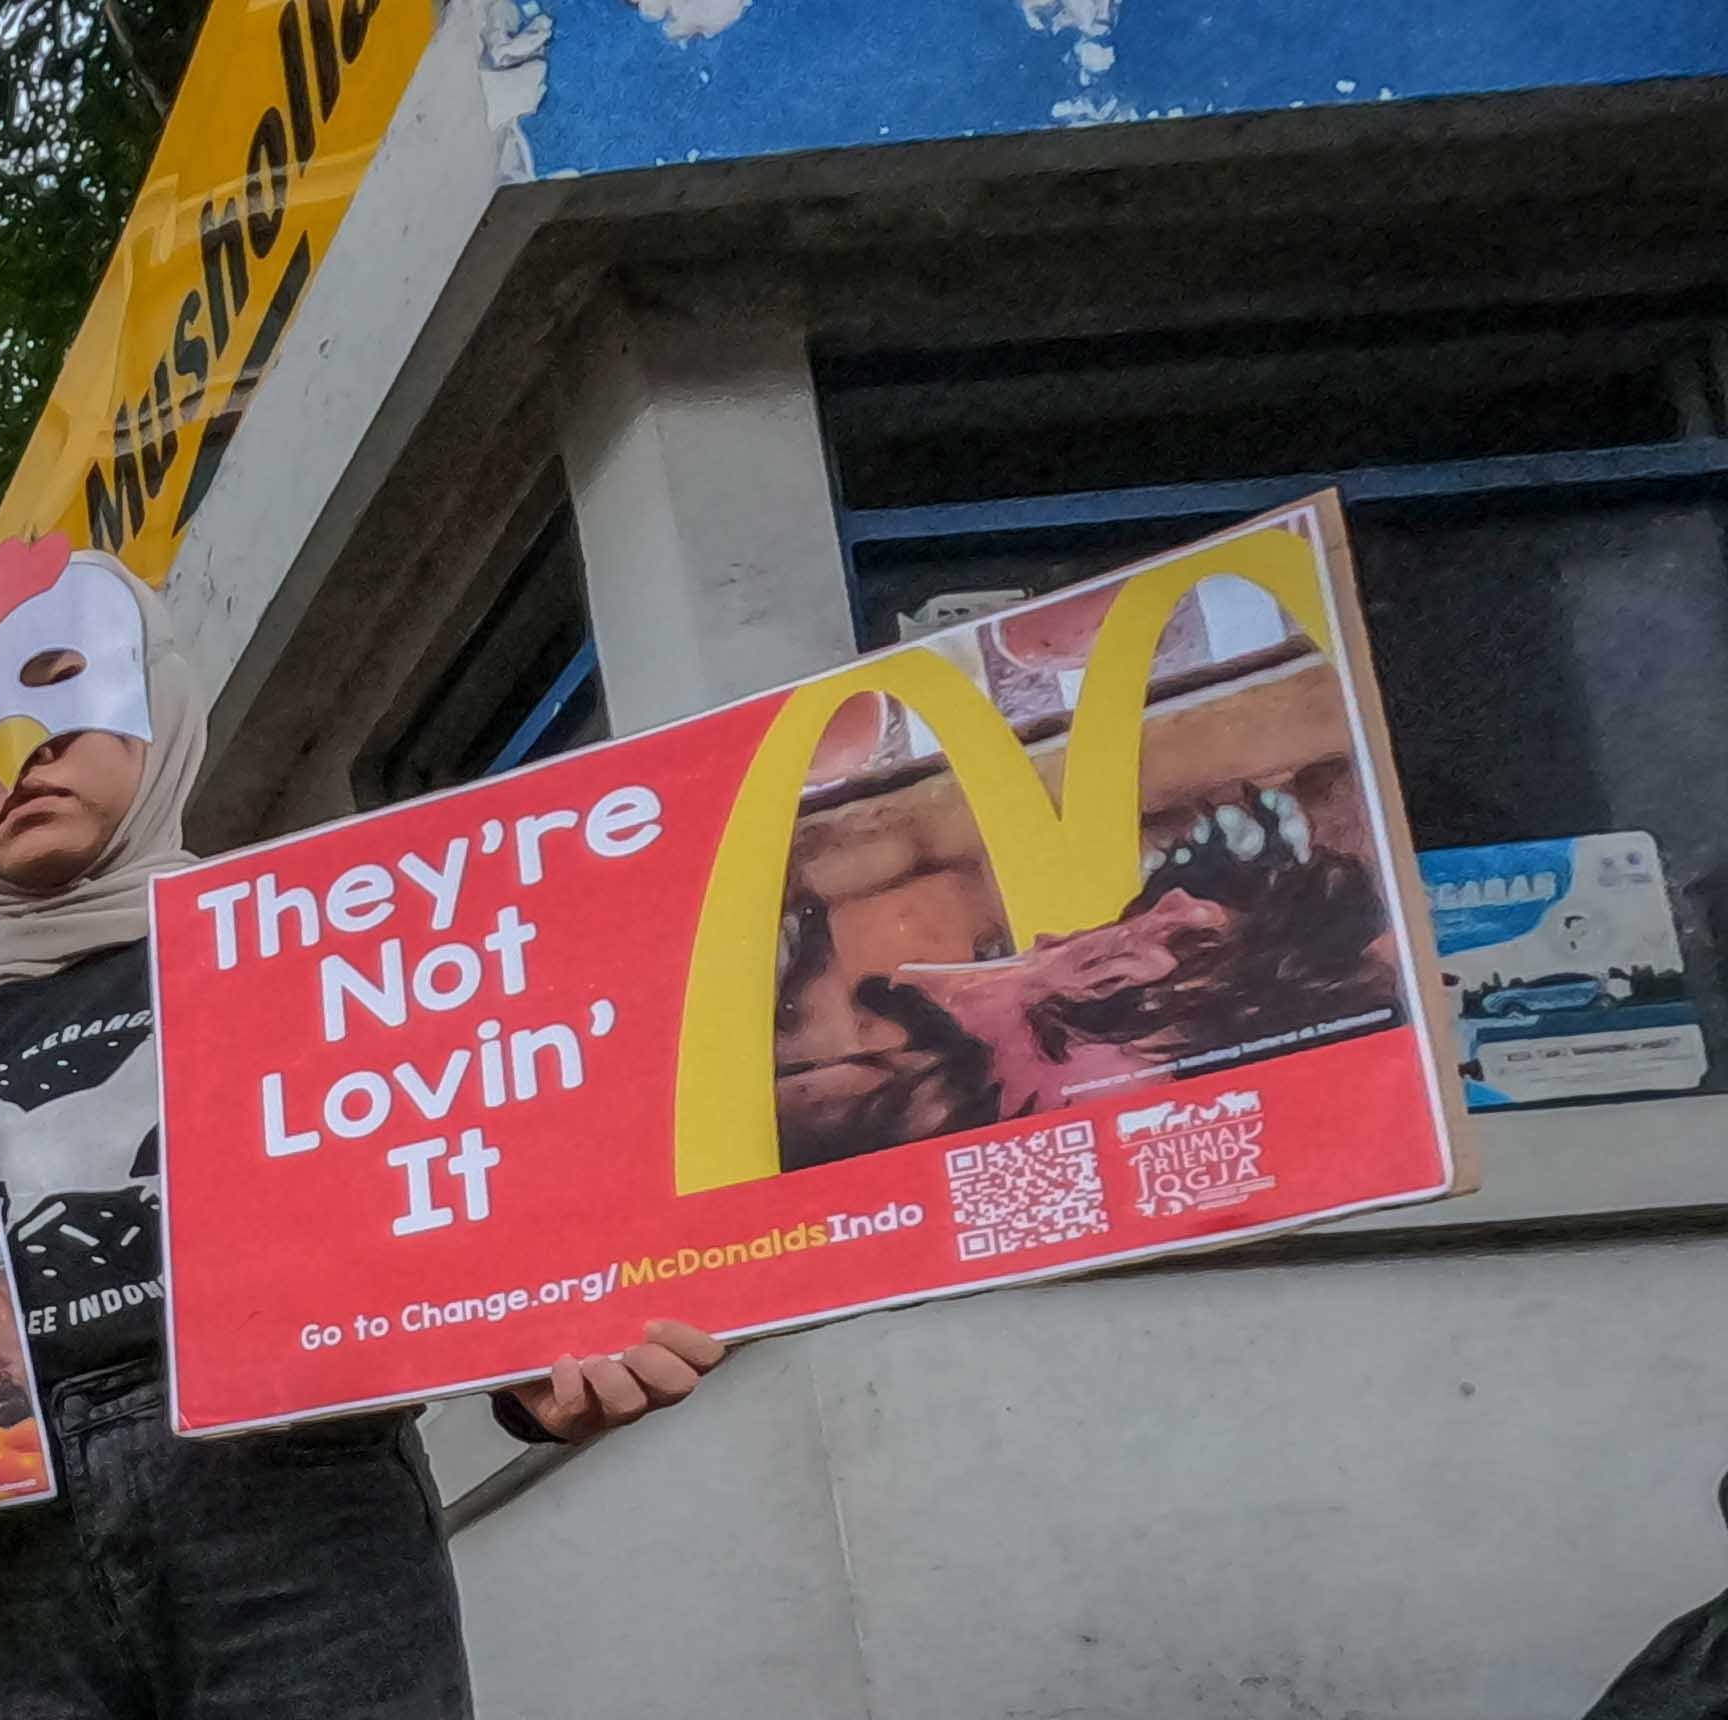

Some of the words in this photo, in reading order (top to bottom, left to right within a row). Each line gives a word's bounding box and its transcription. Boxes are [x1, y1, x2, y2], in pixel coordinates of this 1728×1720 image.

[197, 785, 664, 971] They're
[320, 905, 536, 1042] Not
[261, 998, 616, 1158] Lovin'
[387, 1128, 501, 1237] It
[68, 1273, 166, 1326] INDON
[300, 1323, 343, 1350] Go
[354, 1314, 389, 1341] to
[401, 1203, 923, 1332] Change.org/McDonaldsIndo
